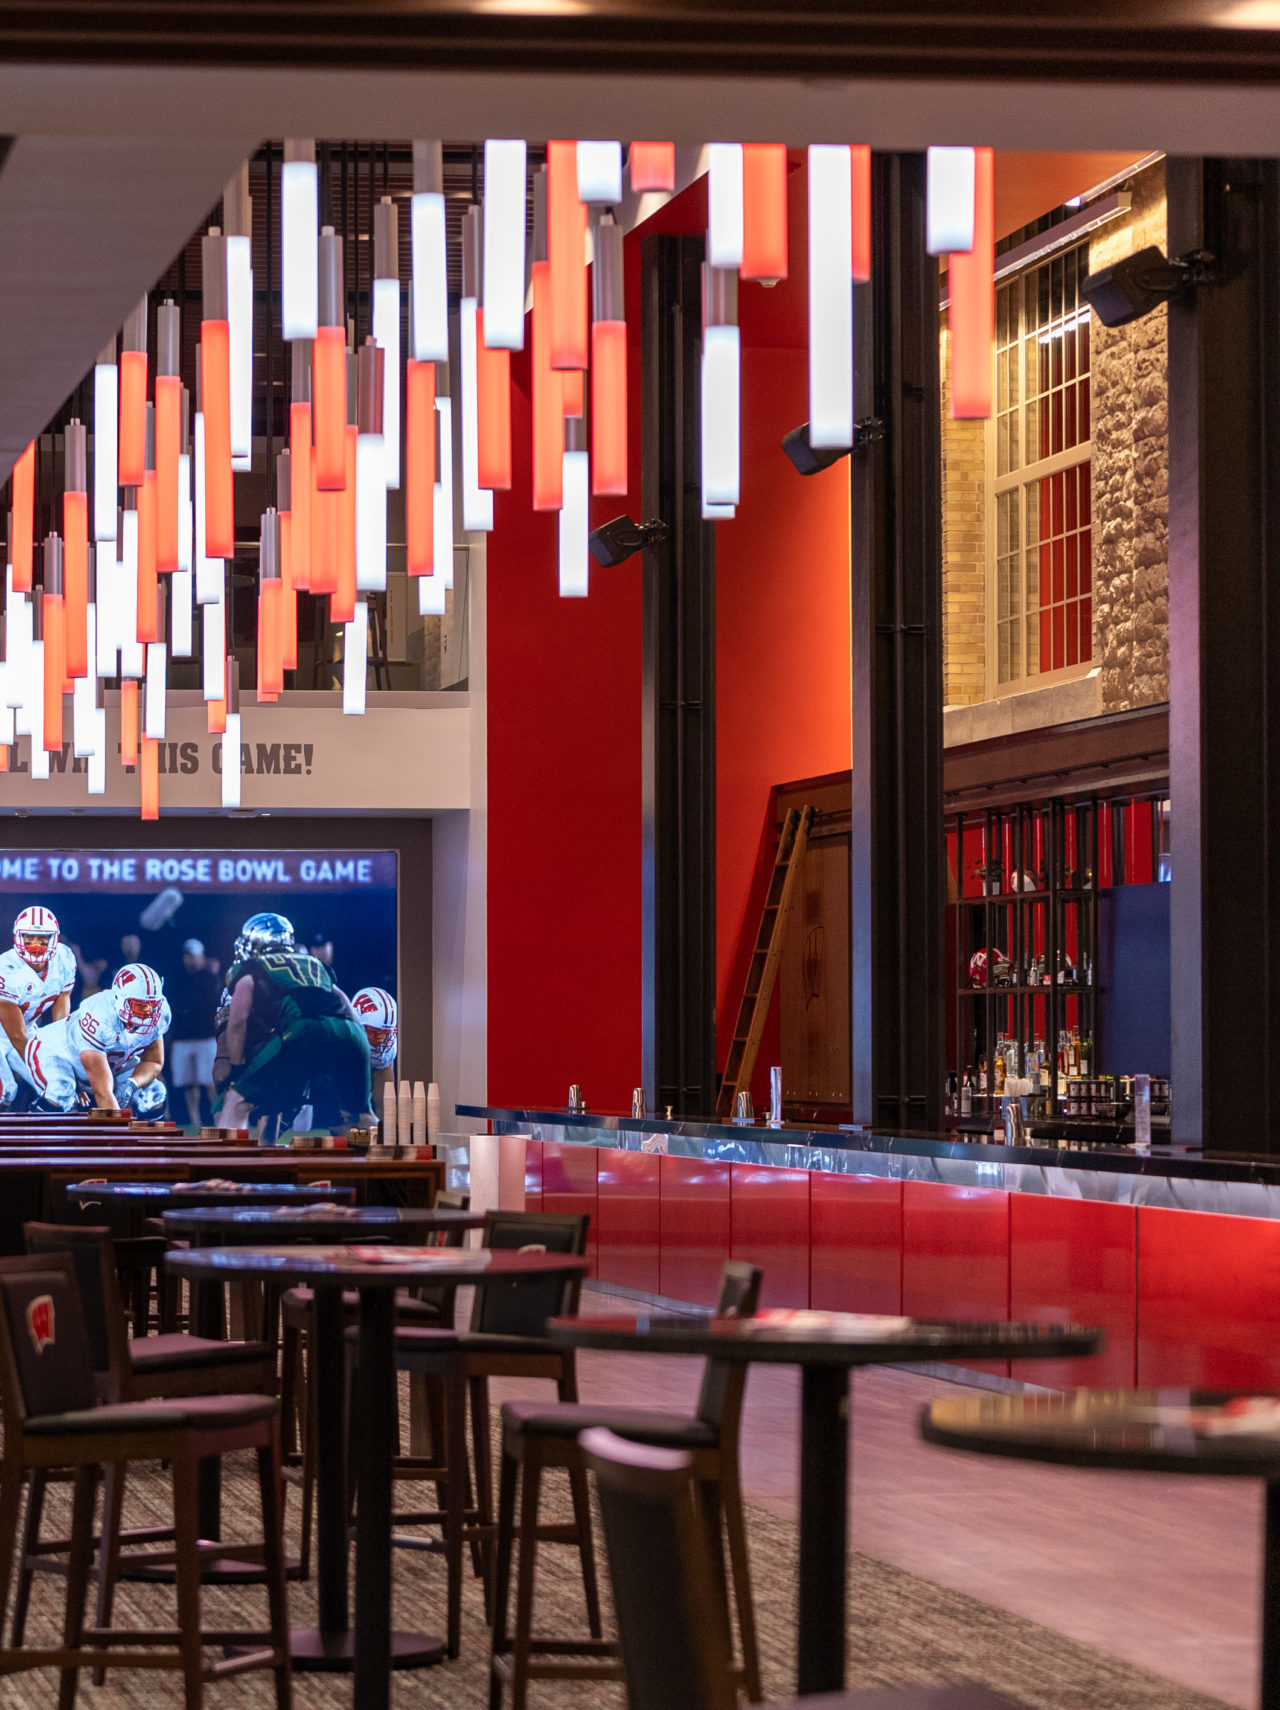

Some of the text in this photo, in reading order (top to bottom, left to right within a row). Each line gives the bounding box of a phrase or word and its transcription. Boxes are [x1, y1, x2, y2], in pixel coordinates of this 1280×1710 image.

[48, 858, 80, 881] TO
[88, 858, 136, 882] THE
[145, 858, 212, 883] ROSE
[219, 859, 291, 883] BOWL
[299, 860, 373, 883] GAME
[81, 1011, 100, 1035] 66
